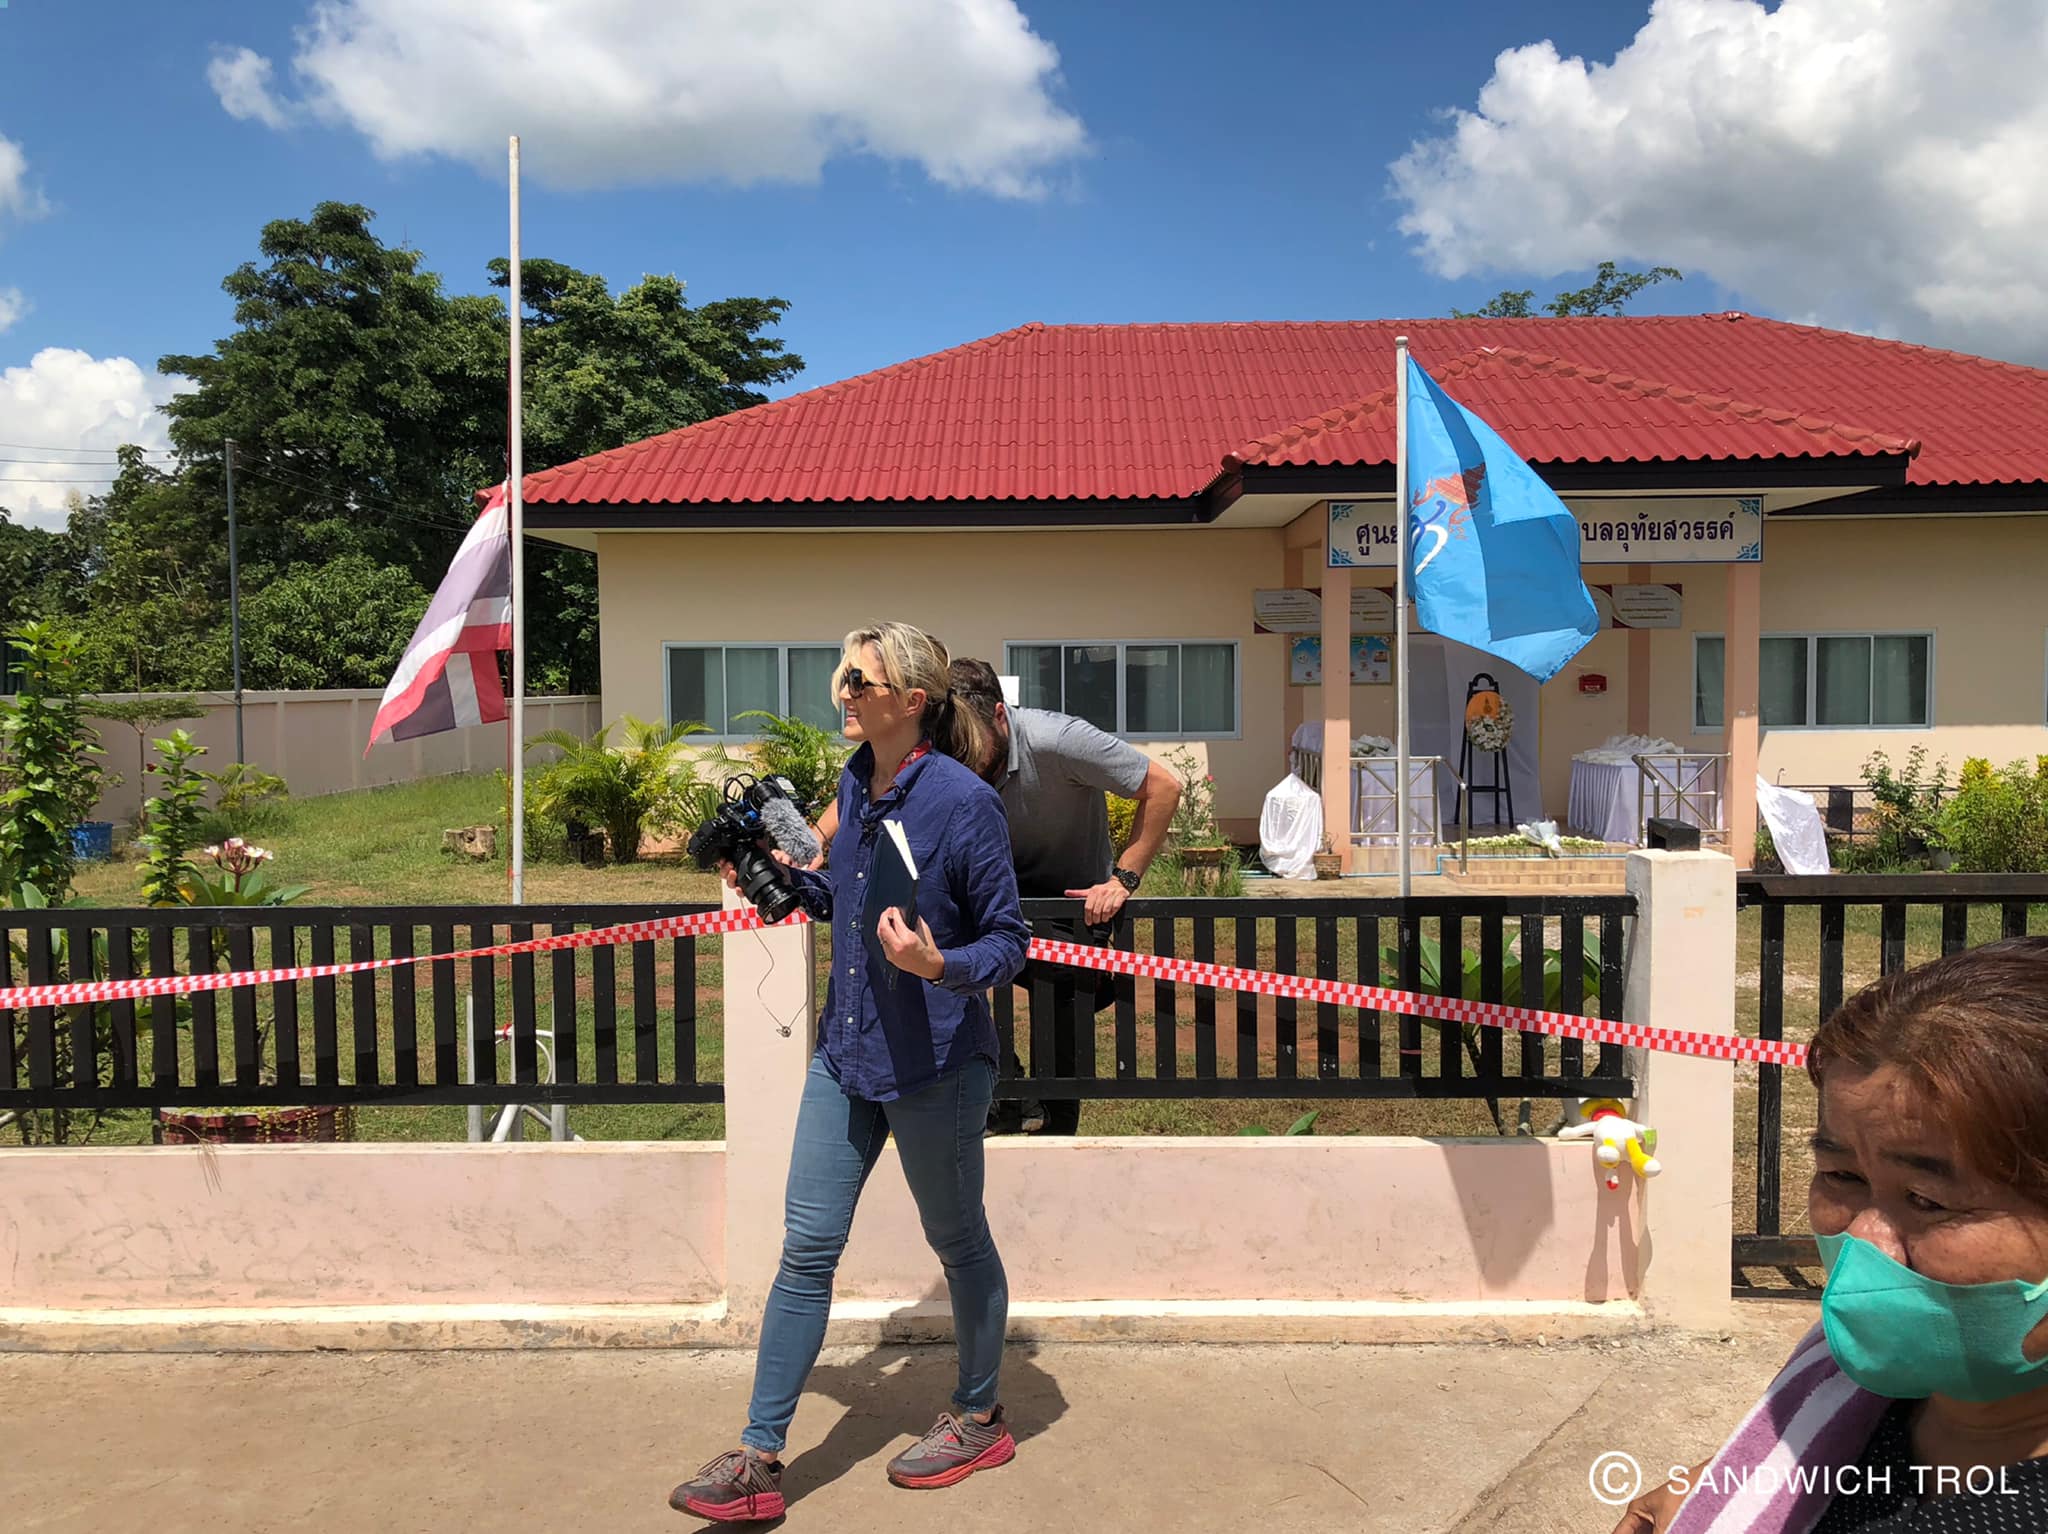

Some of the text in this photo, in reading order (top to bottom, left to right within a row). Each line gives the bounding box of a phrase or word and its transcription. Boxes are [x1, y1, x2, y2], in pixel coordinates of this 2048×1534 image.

[1581, 511, 1736, 553] บลอุทัยสวรรค์
